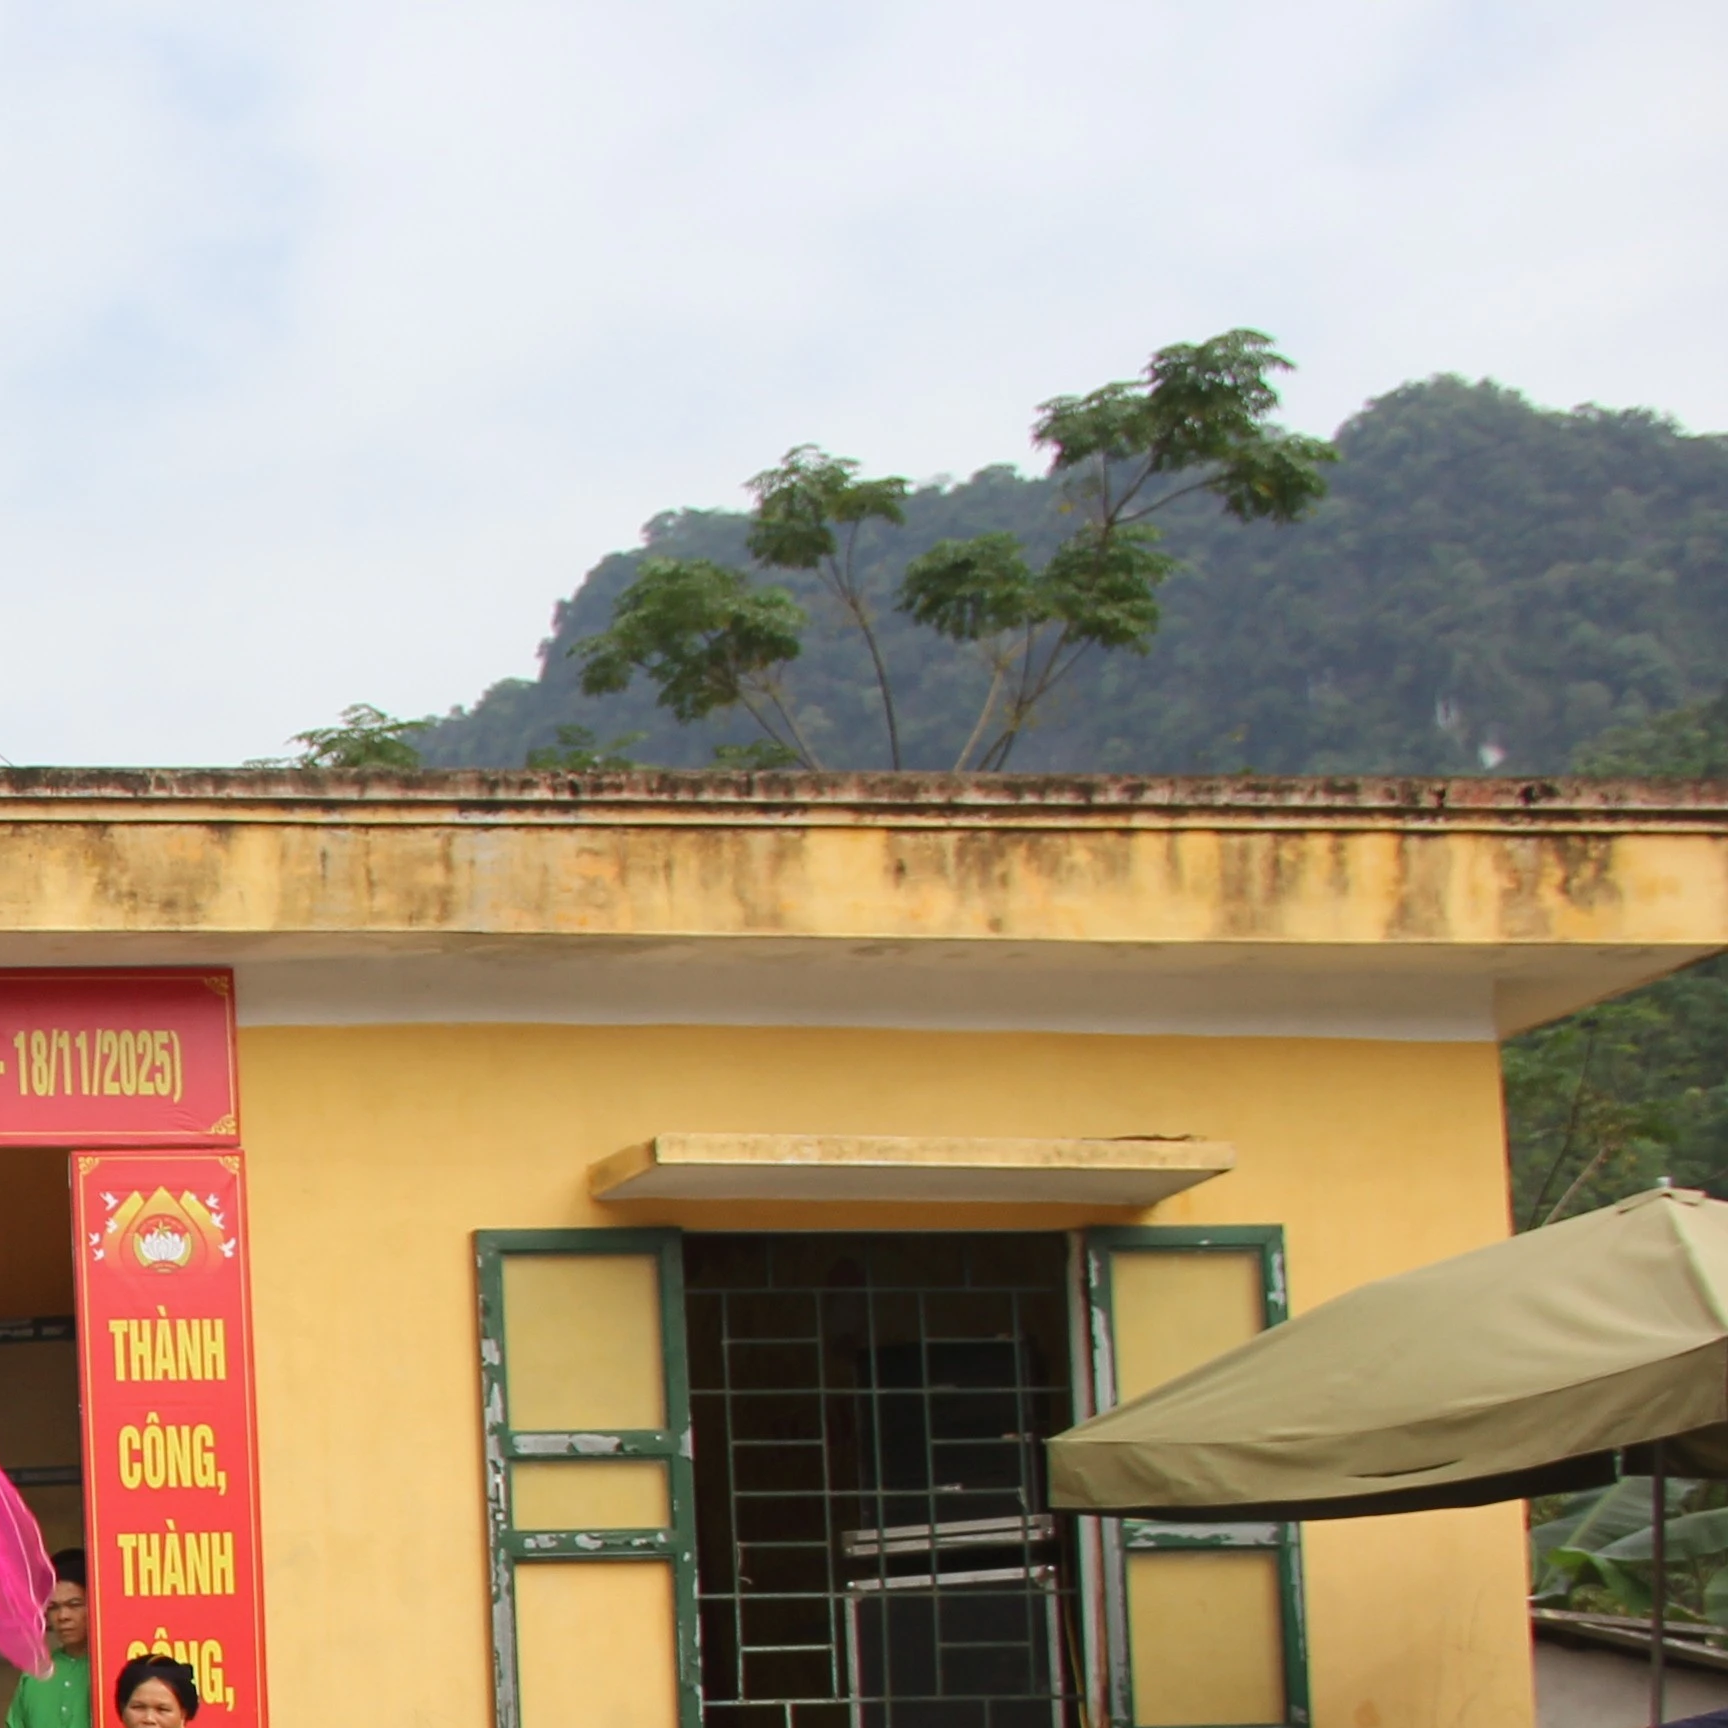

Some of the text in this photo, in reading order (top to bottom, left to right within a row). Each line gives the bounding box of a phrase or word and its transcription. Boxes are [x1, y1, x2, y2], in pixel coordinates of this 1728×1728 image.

[12, 1027, 185, 1104] 18/11/2025)
[107, 1304, 228, 1382] THÀNH
[118, 1411, 228, 1496] CÔNG,
[116, 1518, 236, 1597] THÀNH
